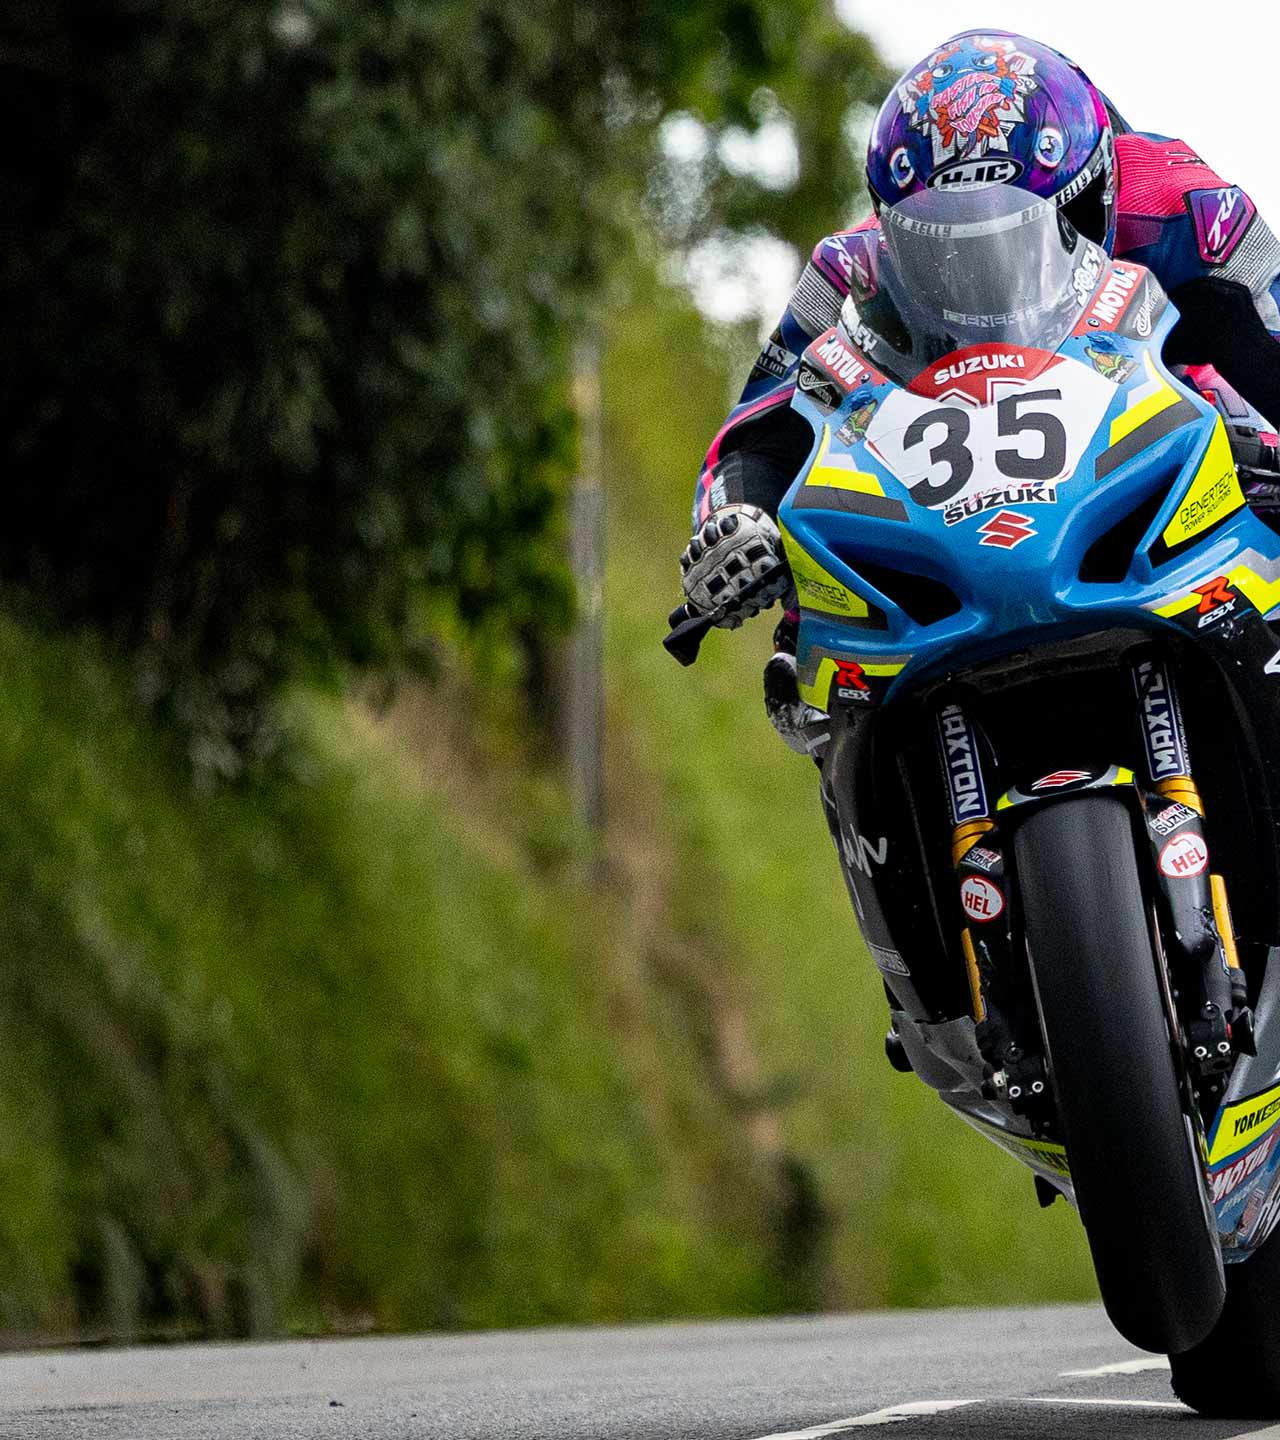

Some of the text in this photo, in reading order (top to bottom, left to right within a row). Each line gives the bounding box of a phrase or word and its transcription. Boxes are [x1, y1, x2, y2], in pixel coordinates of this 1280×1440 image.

[939, 161, 1011, 189] HJC
[1055, 172, 1089, 208] KELLY
[910, 220, 952, 238] KELLY
[1091, 268, 1139, 324] MOTUL
[816, 339, 865, 386] MOTUL
[933, 354, 1025, 386] SUZUKI
[903, 389, 1067, 508] 35
[944, 488, 1056, 526] SUZUKI
[1180, 471, 1234, 525] GENERTECH
[1191, 576, 1237, 614] R
[1197, 598, 1237, 629] GSX
[834, 659, 871, 690] R
[837, 687, 872, 701] GSX
[1171, 847, 1205, 874] HEL
[964, 891, 992, 916] HEL
